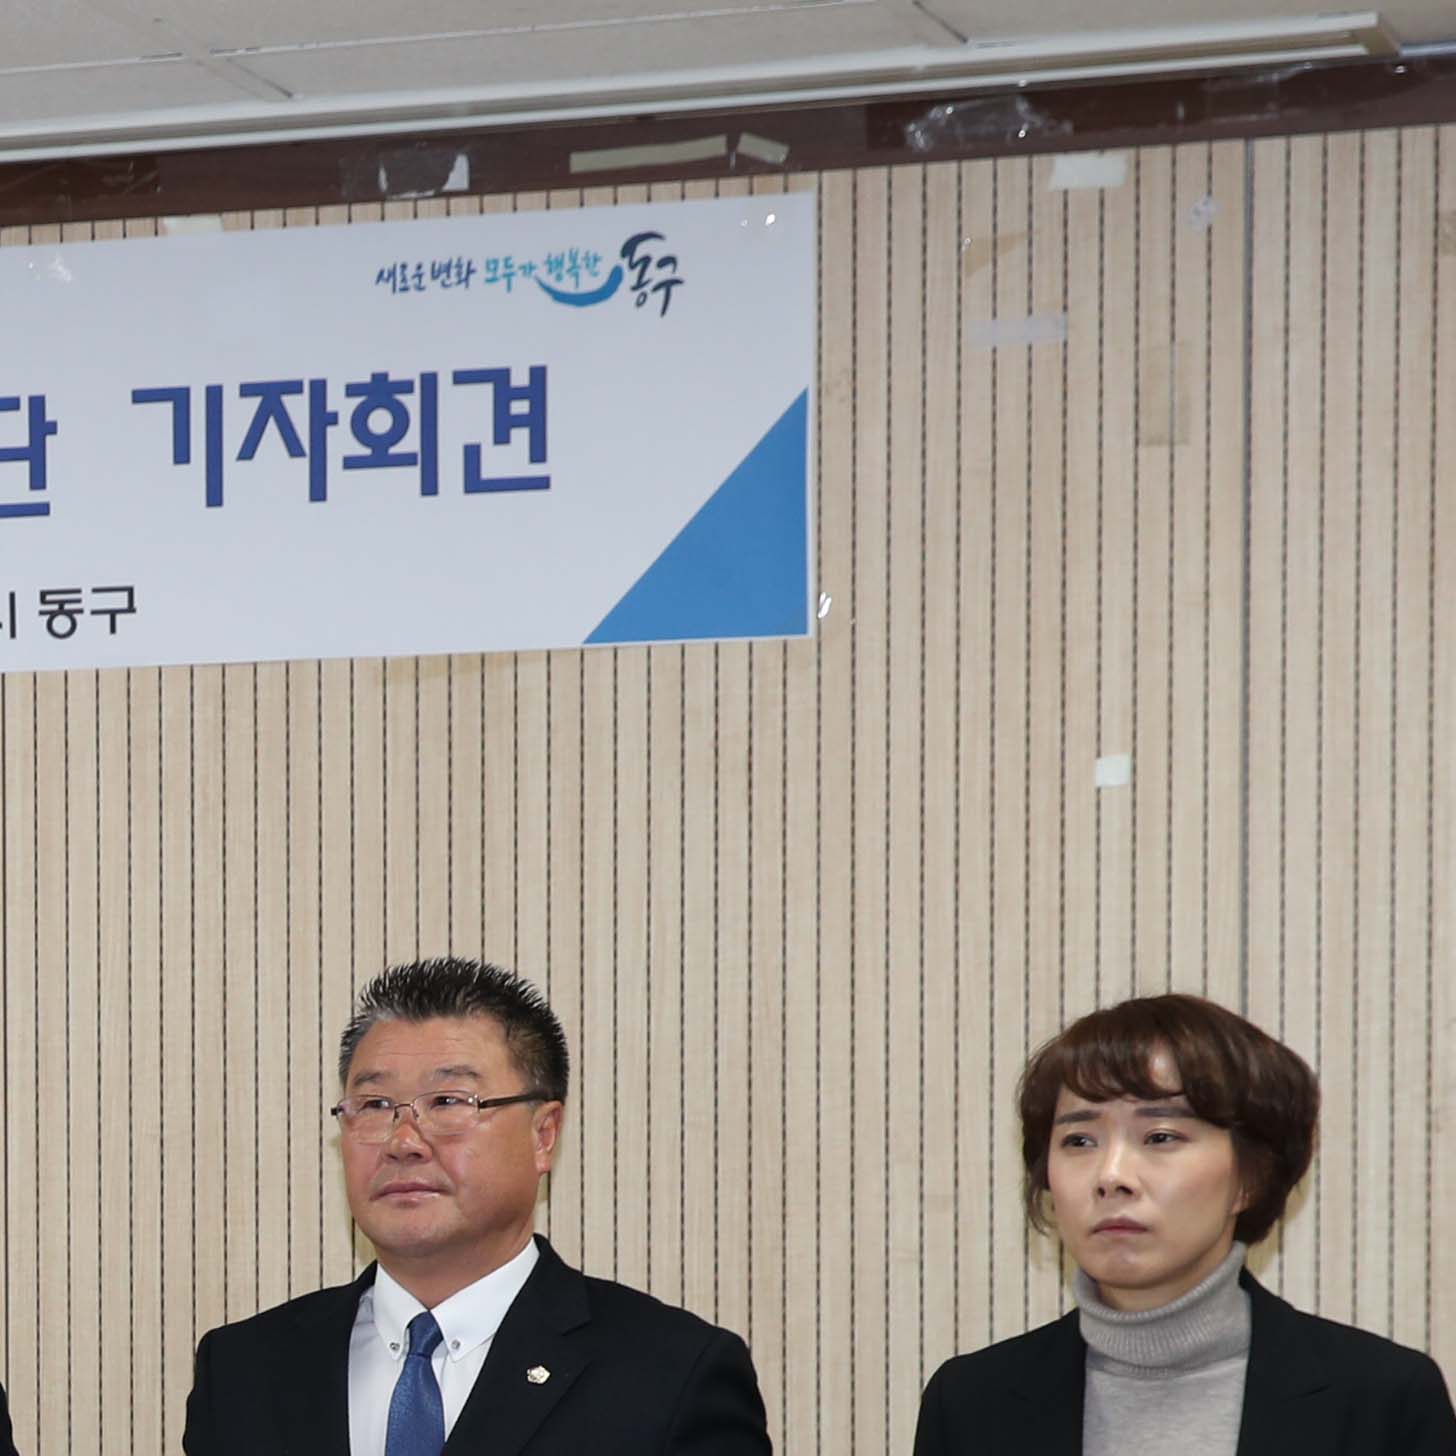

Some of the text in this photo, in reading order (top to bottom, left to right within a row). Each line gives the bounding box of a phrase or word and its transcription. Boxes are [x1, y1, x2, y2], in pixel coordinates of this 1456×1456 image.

[484, 254, 538, 294] 모두가
[543, 247, 604, 289] 행복한
[619, 230, 686, 319] 동구
[131, 364, 551, 508] 기자회견
[38, 585, 137, 640] 동구
